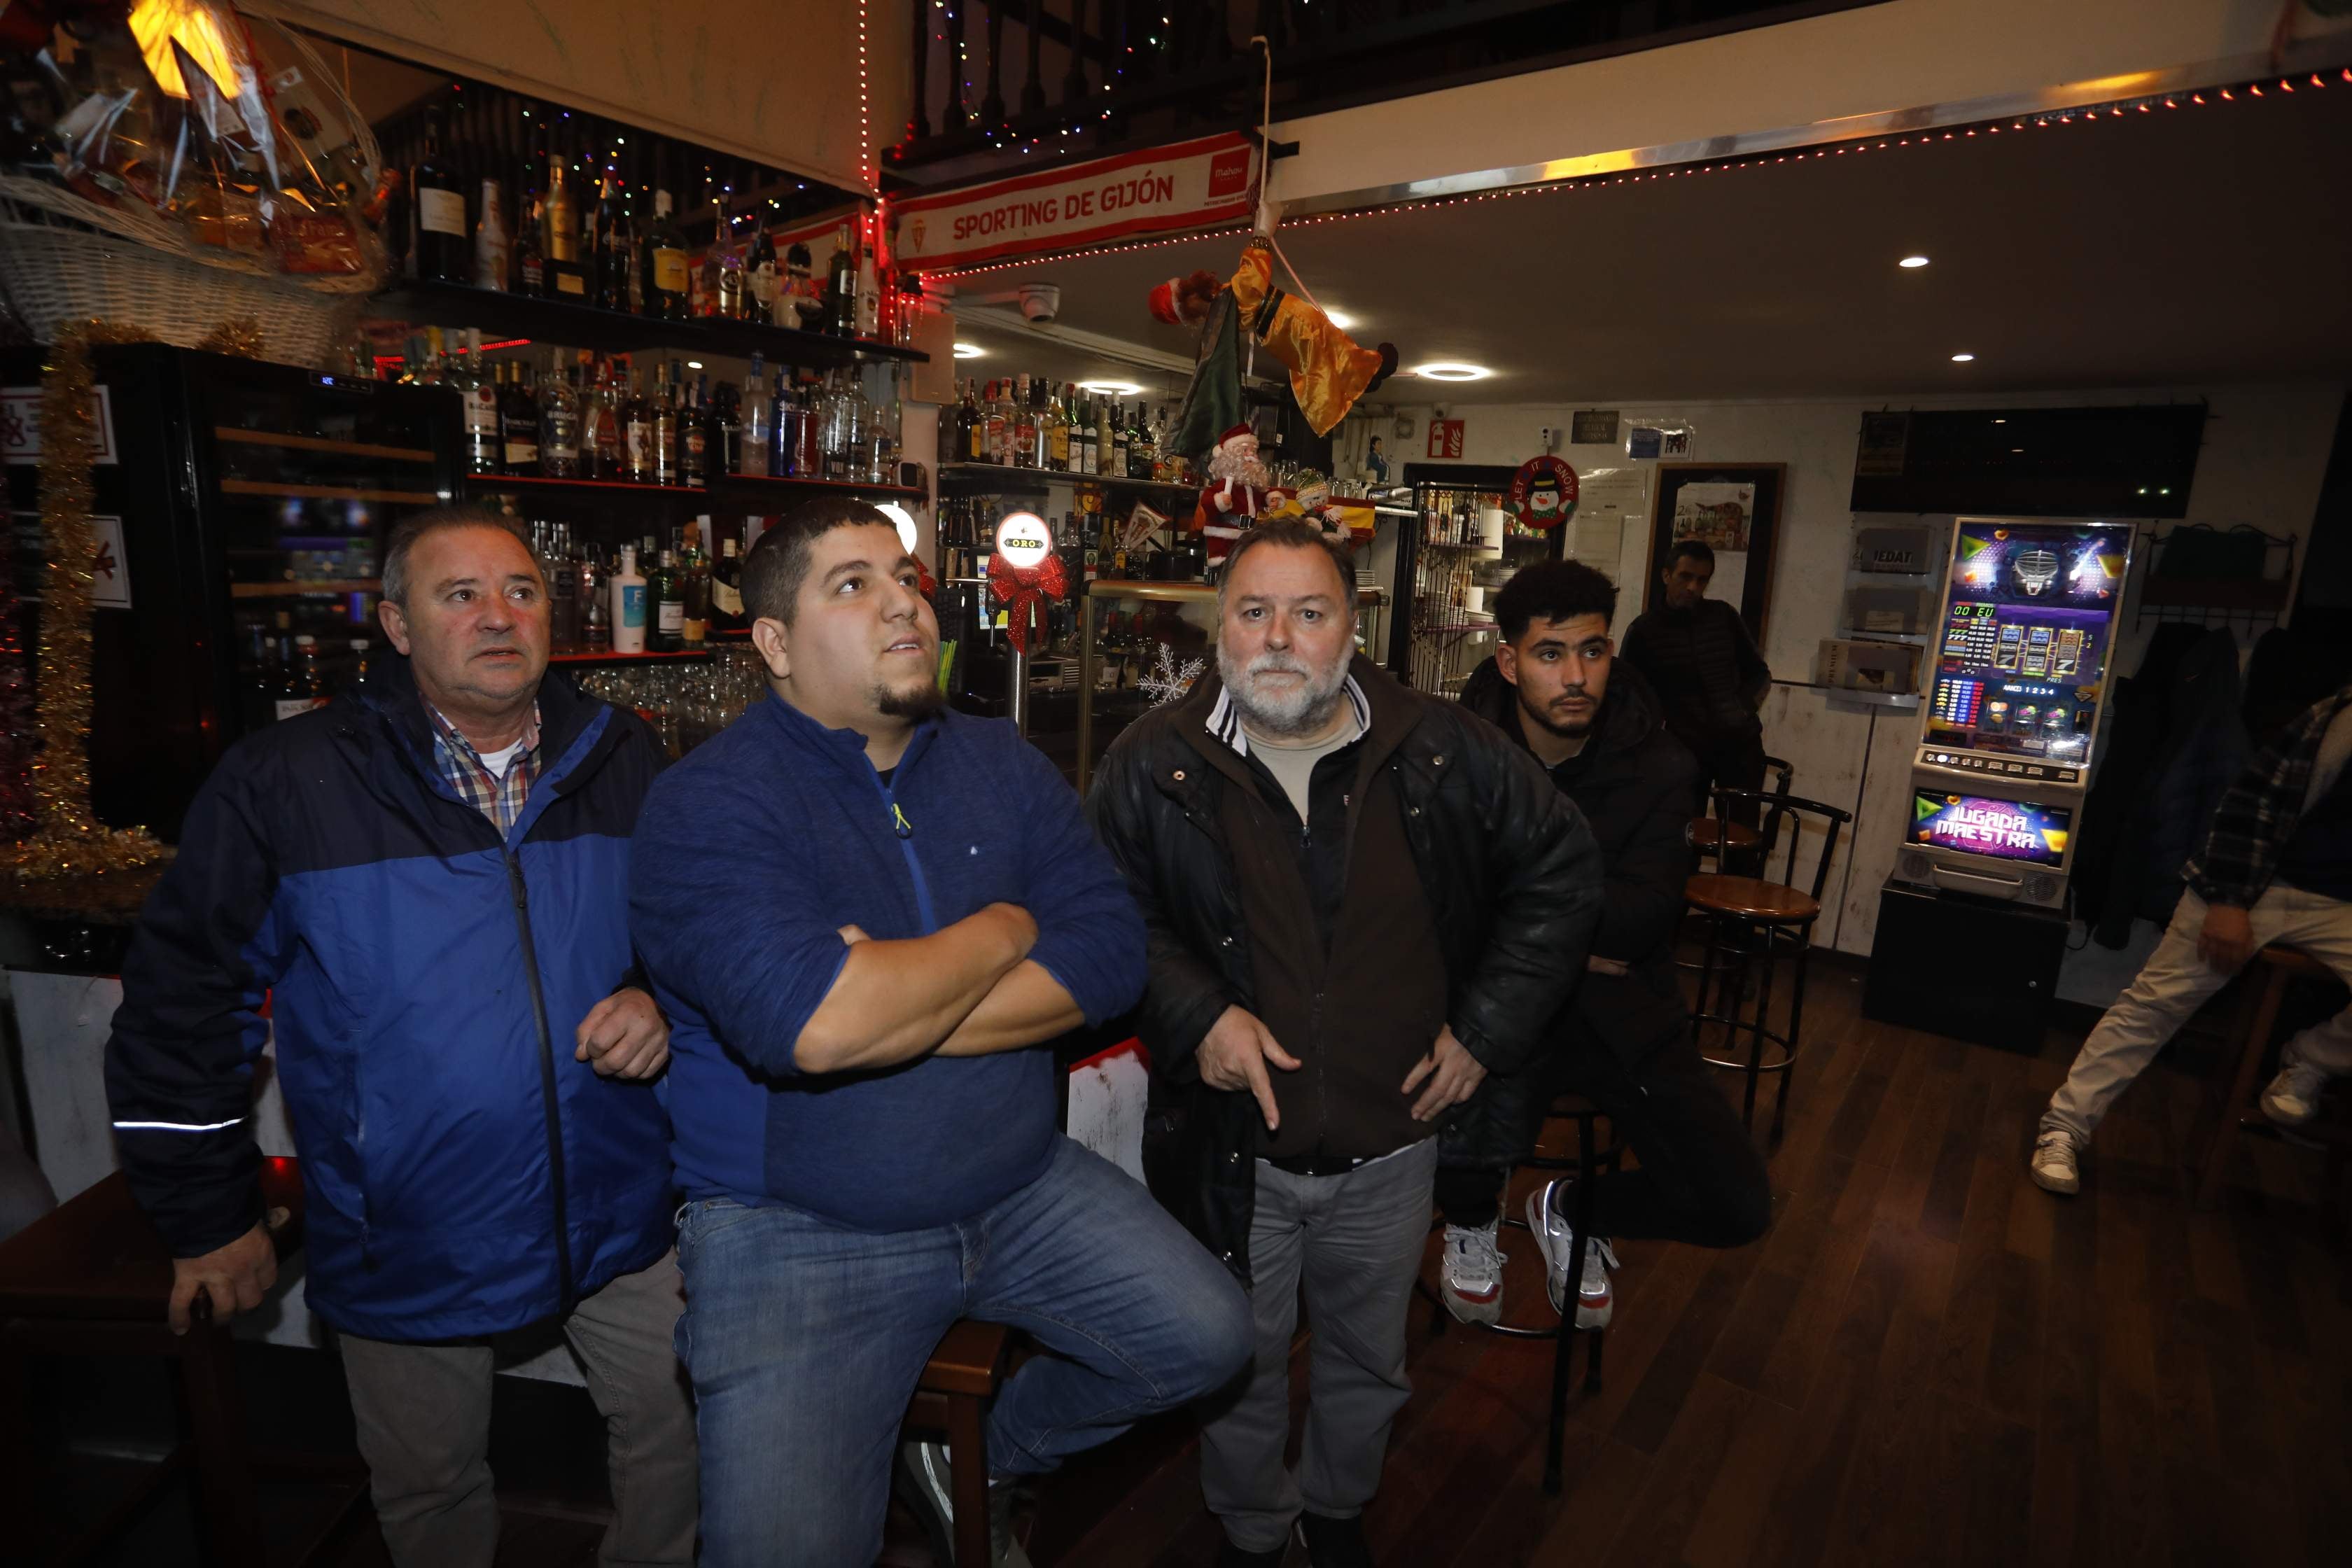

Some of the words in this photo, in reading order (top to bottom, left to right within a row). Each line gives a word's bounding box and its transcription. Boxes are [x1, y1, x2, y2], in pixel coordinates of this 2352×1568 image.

[953, 198, 1058, 241] SPORTING
[1065, 189, 1095, 220] DE
[1100, 170, 1175, 213] GIJÓN
[1514, 479, 1524, 500] LET
[1530, 460, 1540, 472] IT
[1555, 463, 1574, 495] SNOW
[1012, 539, 1036, 547] ORO
[1954, 606, 1970, 615] 00
[1977, 607, 1994, 617] EU
[1948, 806, 2028, 832] JUGADA
[1935, 820, 2036, 849] MAESTRA
